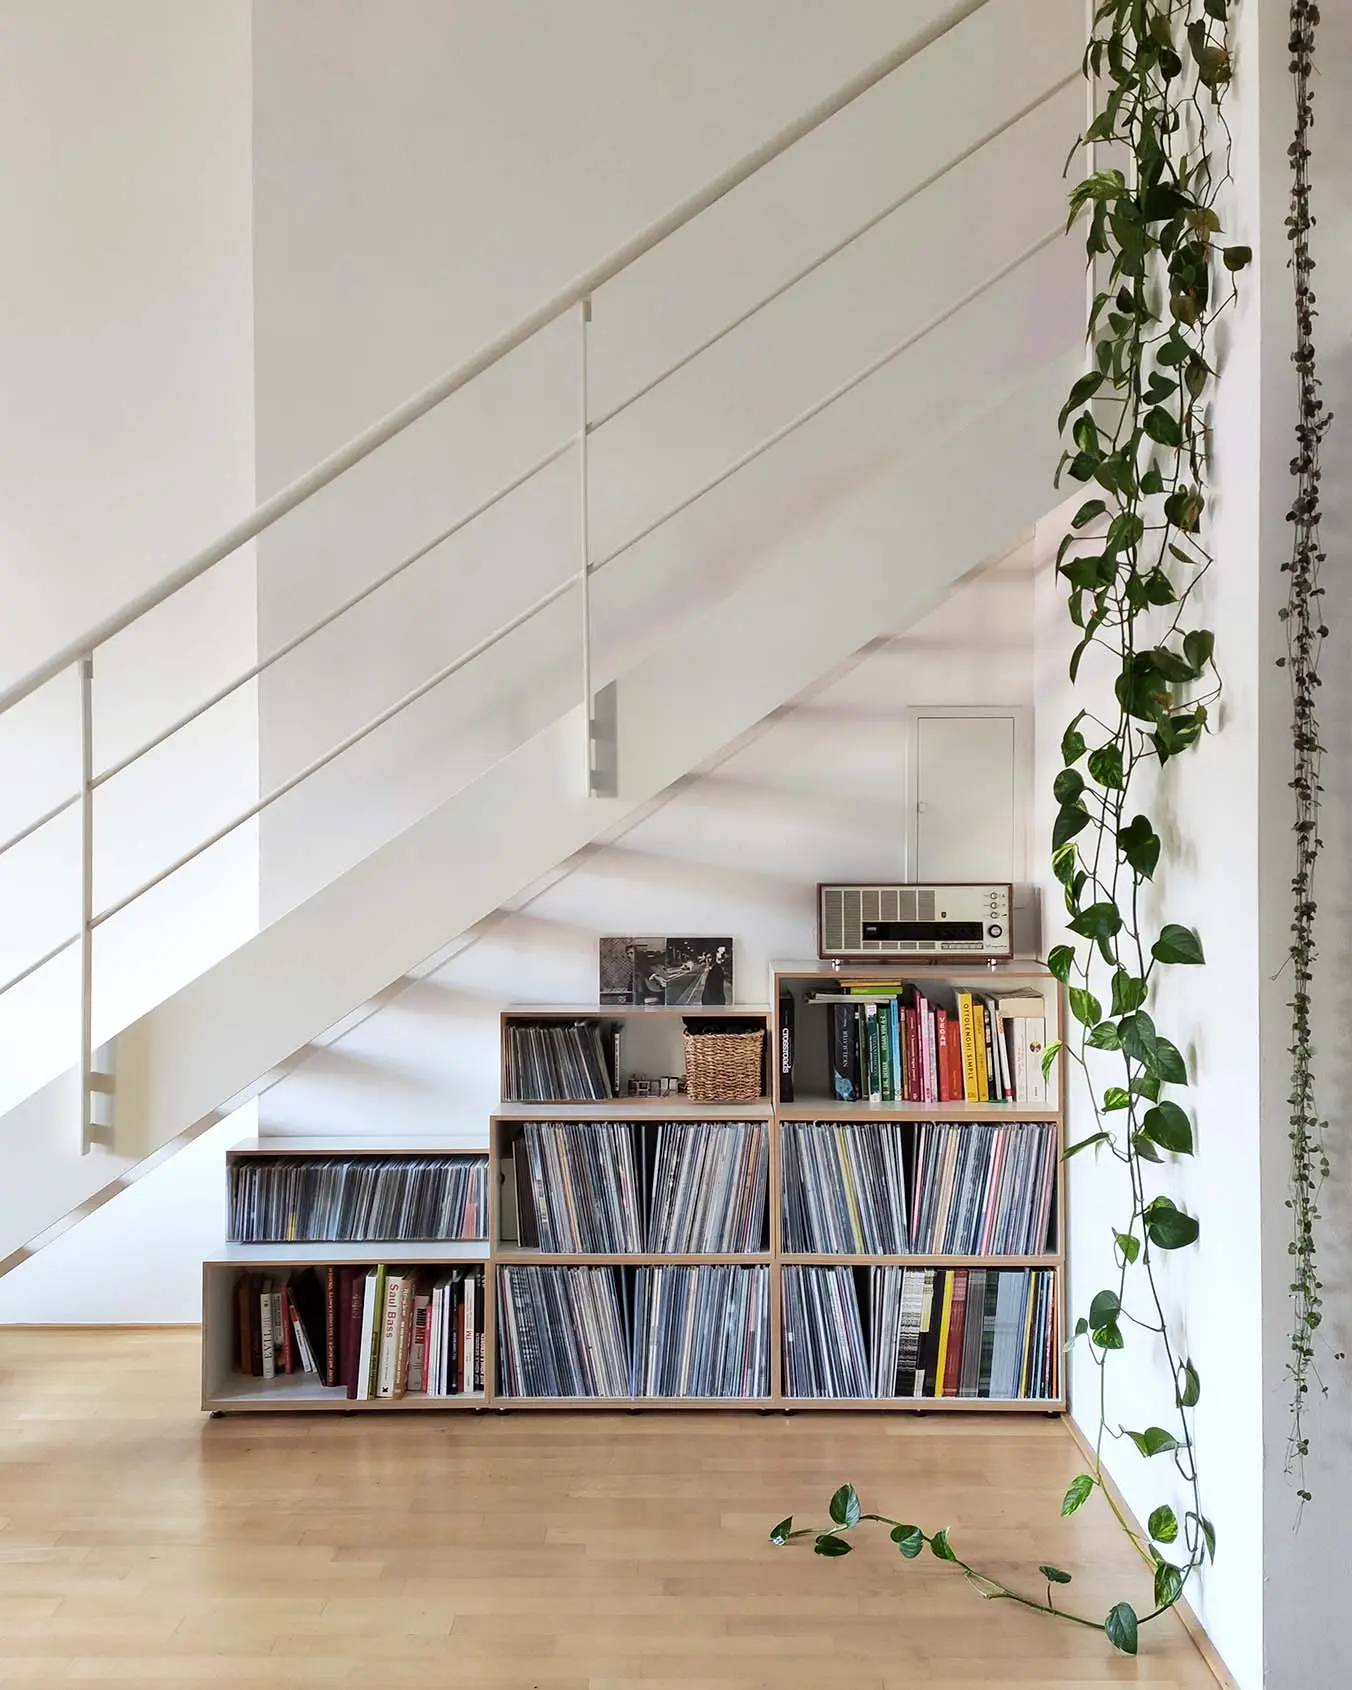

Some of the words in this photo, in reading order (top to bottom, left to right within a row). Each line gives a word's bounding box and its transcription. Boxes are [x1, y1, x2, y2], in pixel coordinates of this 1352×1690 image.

[963, 1003, 972, 1051] OTTOLENGHI
[782, 1028, 792, 1073] crossroads
[389, 1284, 400, 1308] Saul
[386, 1311, 397, 1339] Bass
[415, 1327, 425, 1345] MEN
